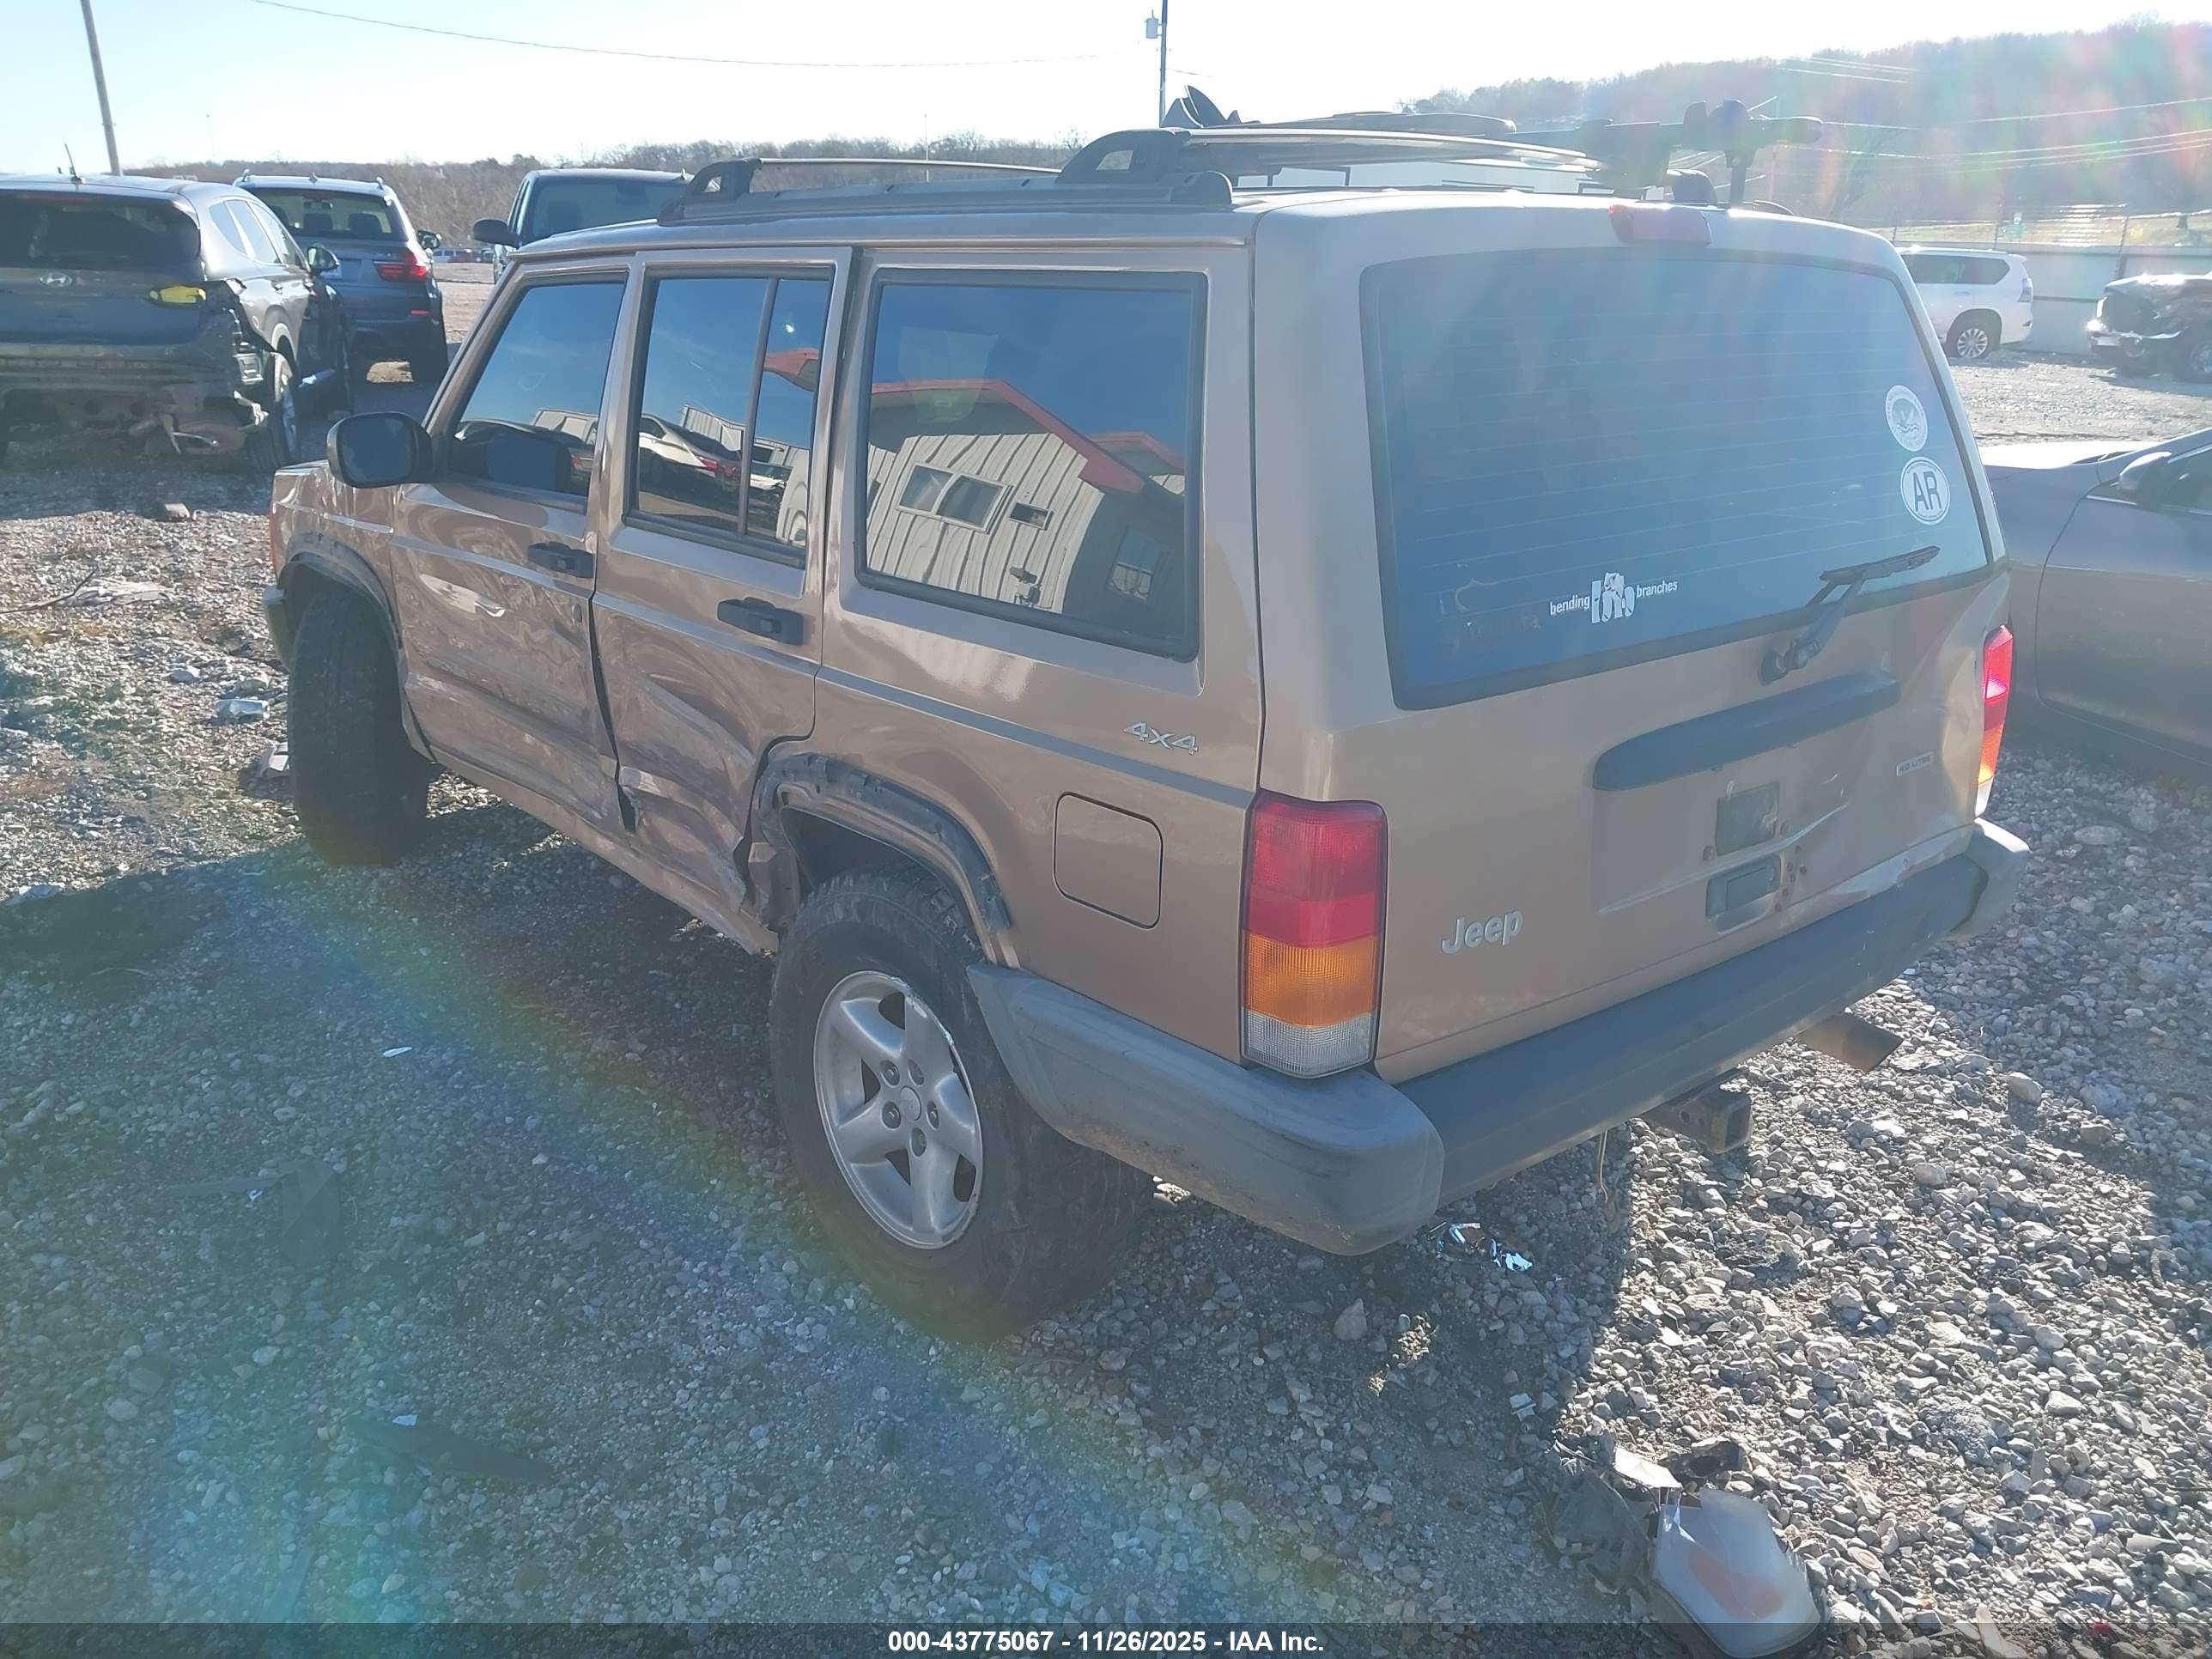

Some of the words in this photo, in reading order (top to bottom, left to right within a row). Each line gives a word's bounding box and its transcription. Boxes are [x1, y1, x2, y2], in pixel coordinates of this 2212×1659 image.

[1912, 470, 1942, 513] AR
[1549, 593, 1590, 617] bending
[1636, 580, 1679, 599] branches
[1441, 908, 1523, 955] Jeep
